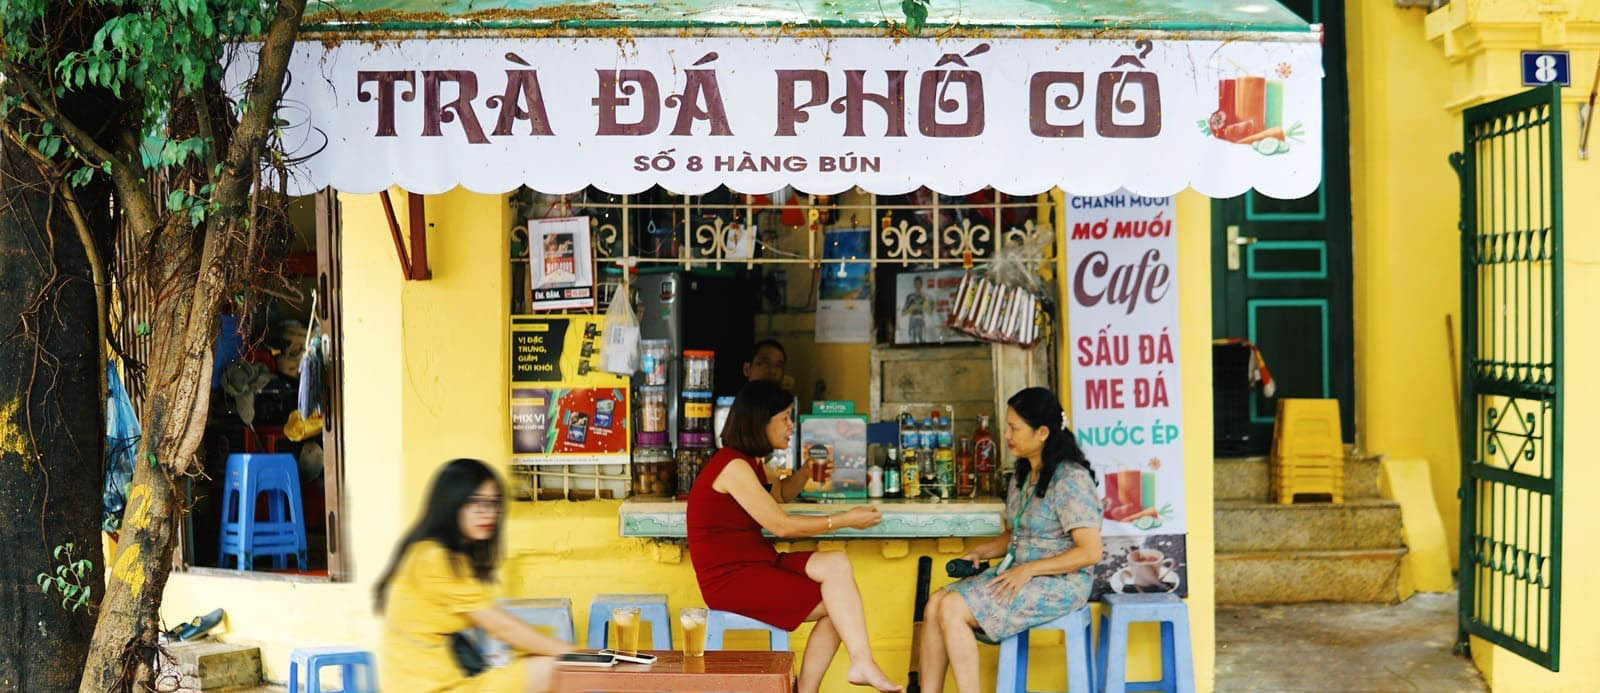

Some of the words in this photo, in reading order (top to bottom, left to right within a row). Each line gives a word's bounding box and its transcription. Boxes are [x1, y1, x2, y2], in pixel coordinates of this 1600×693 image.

[1535, 55, 1558, 82] 8
[357, 52, 556, 144] TRÀ
[591, 52, 735, 137] ĐÁ
[773, 42, 990, 138] PHỐ
[1029, 40, 1162, 138] CỔ
[633, 148, 676, 172] SỐ
[686, 156, 704, 172] 8
[714, 152, 808, 172] HÀNG
[819, 151, 881, 172] BÚN
[1072, 195, 1125, 209] CHANH
[1071, 218, 1109, 240] MƠ
[1113, 211, 1172, 239] MUỐI
[1077, 323, 1130, 367] SẤU
[1137, 326, 1174, 365] ĐÁ
[1085, 378, 1125, 410] ME
[1133, 371, 1169, 408] ĐÁ
[513, 414, 533, 423] MIX
[1077, 421, 1145, 447] NƯỚC
[1152, 420, 1178, 445] ÉP
